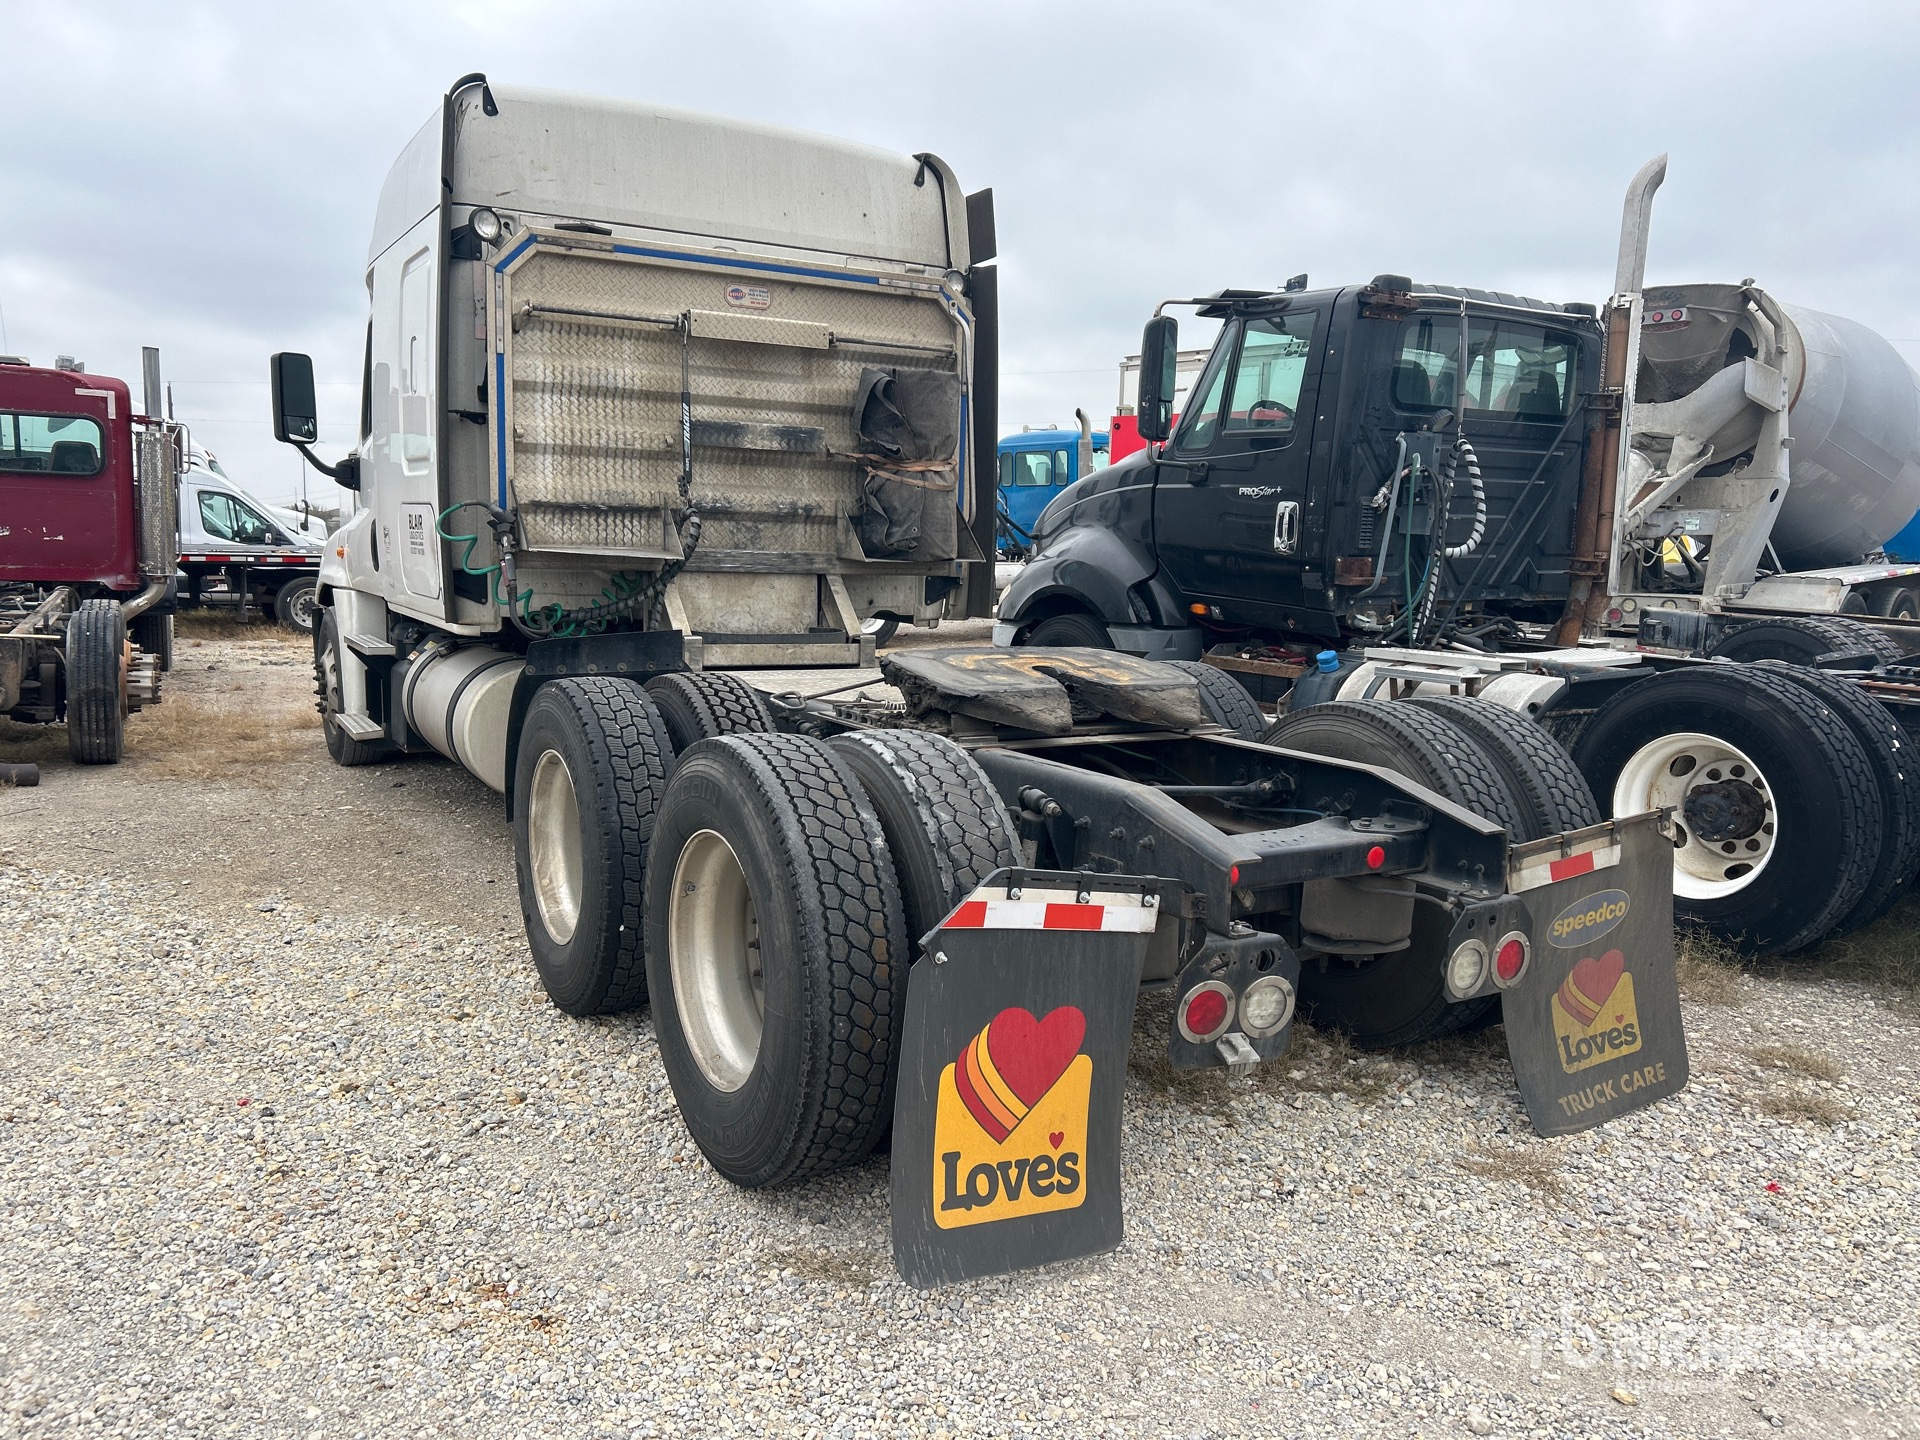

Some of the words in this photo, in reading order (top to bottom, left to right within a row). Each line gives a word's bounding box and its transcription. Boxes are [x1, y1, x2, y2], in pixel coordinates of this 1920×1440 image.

[682, 402, 691, 444] TRACKER
[408, 513, 424, 530] BLAIR
[681, 779, 718, 805] COIN
[1553, 902, 1626, 938] speedco
[1557, 1079, 1619, 1117] TRUCK
[1620, 1062, 1667, 1094] CARE
